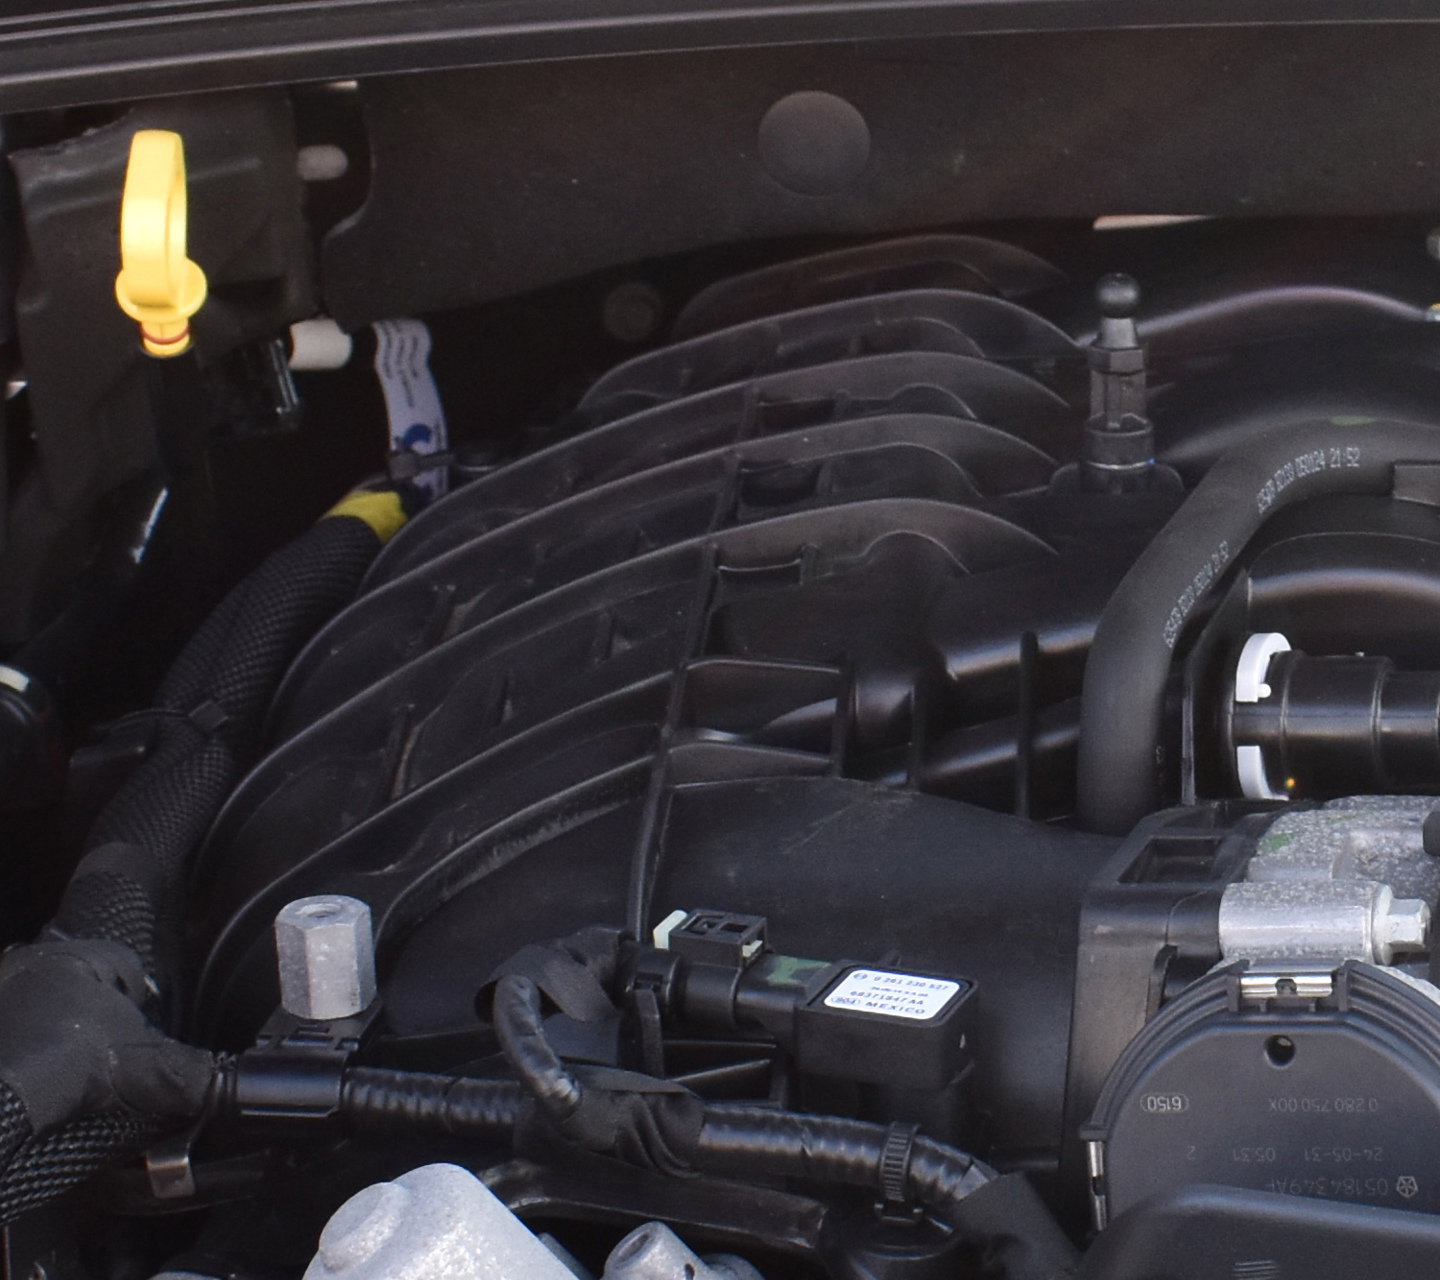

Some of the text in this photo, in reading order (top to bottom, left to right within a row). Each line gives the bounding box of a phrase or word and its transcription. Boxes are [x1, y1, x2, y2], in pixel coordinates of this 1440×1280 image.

[865, 1001, 926, 1015] MEXICO
[1146, 1095, 1183, 1111] 6150
[1304, 1147, 1384, 1162] 24-05-31
